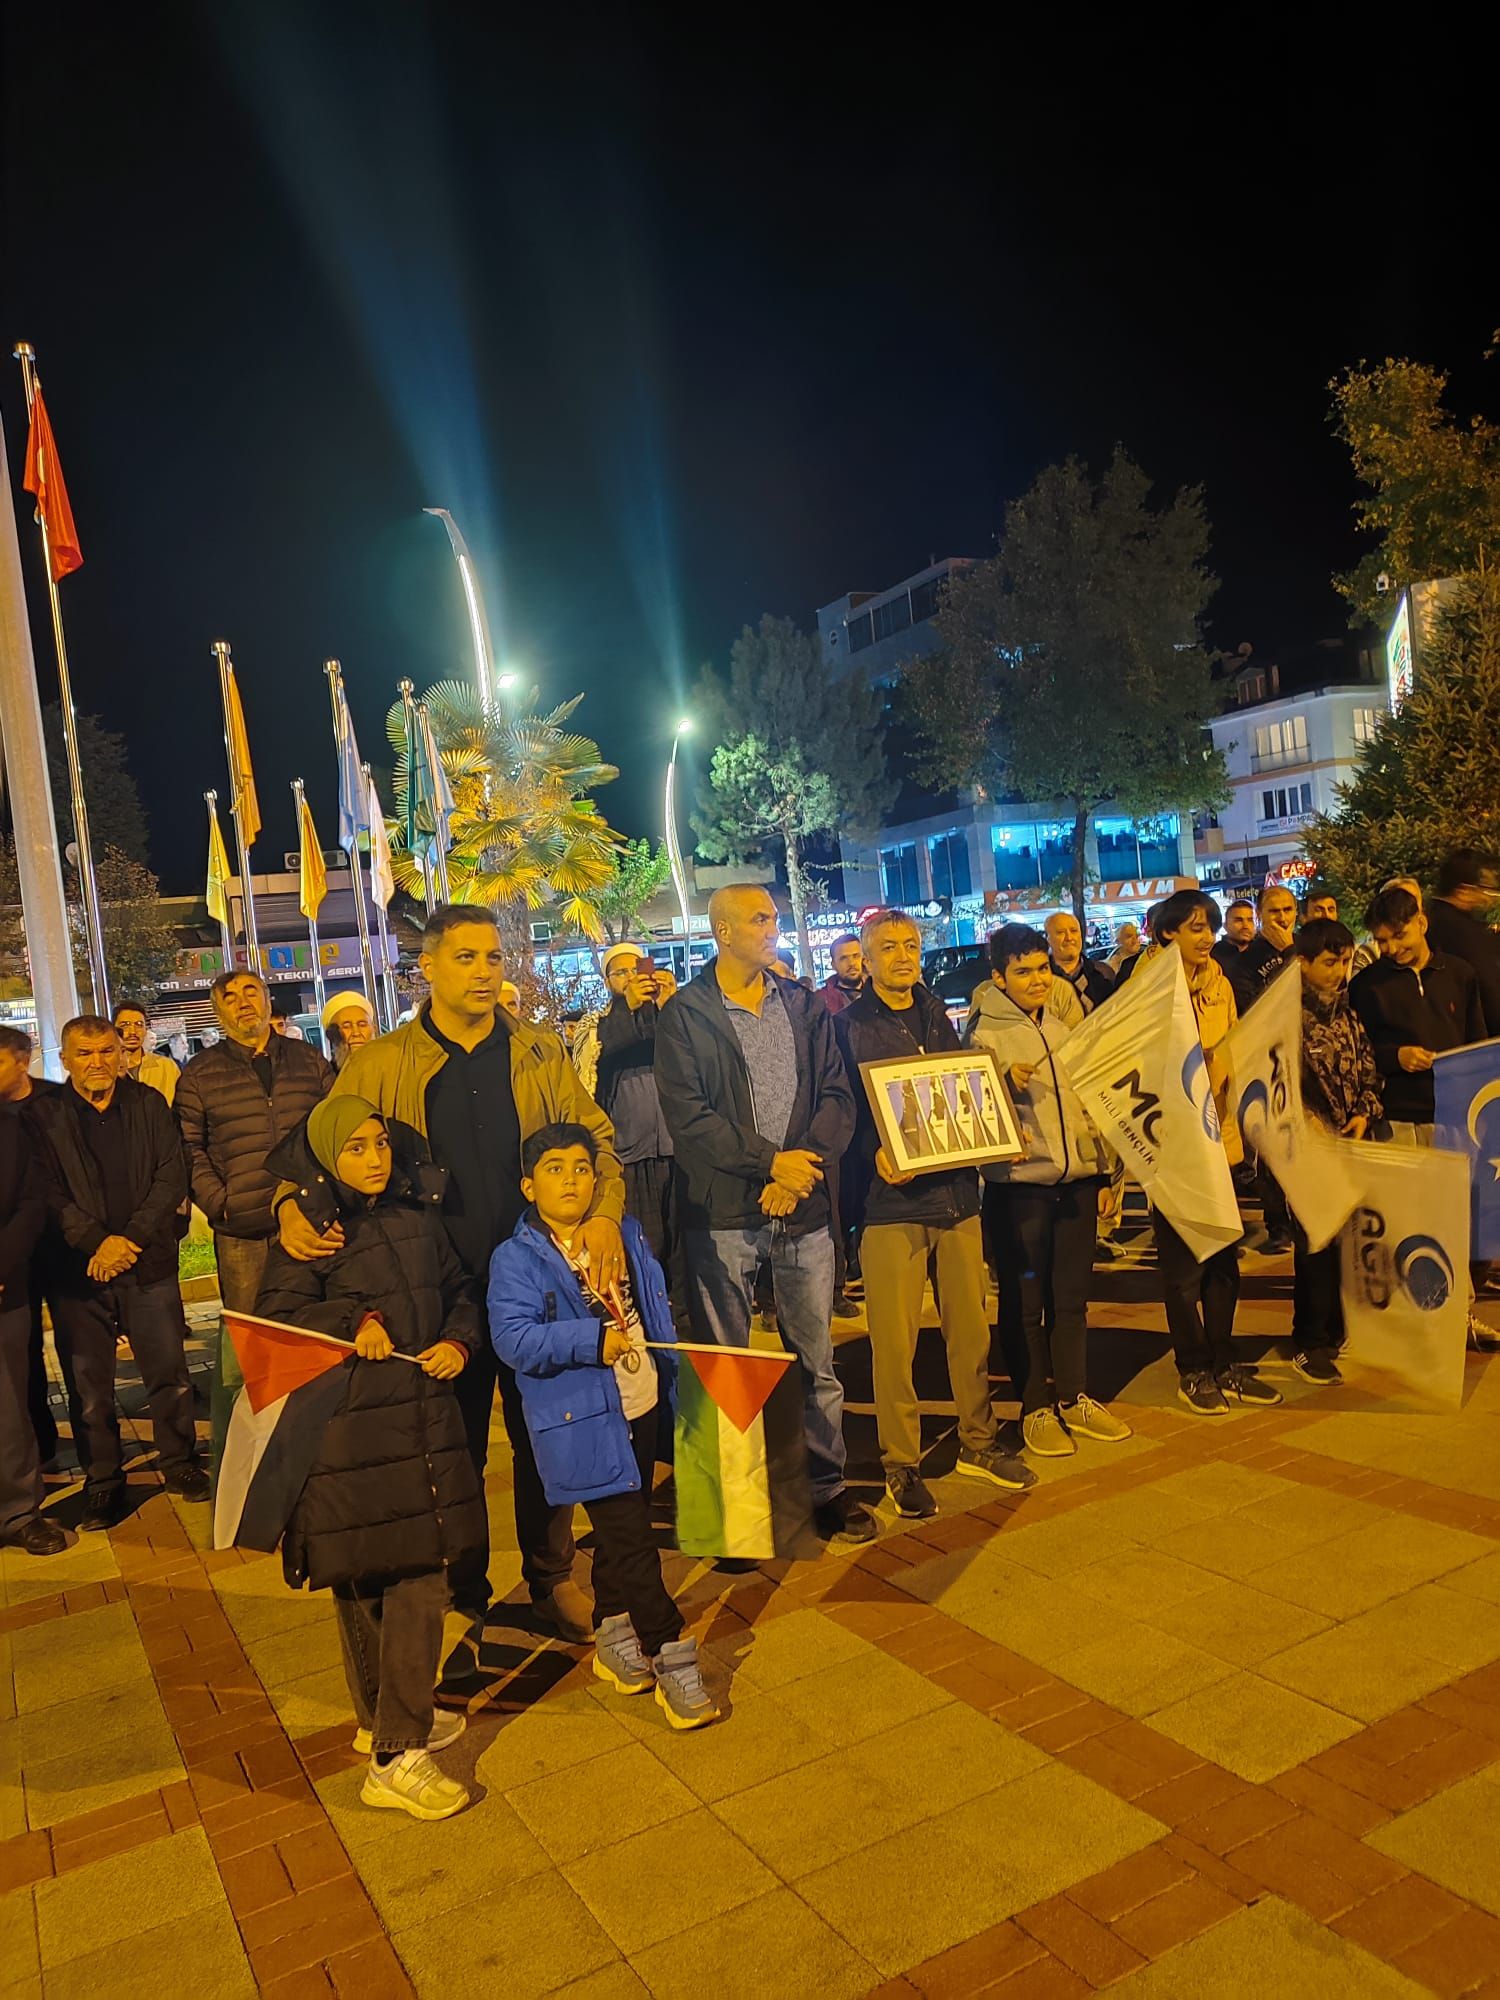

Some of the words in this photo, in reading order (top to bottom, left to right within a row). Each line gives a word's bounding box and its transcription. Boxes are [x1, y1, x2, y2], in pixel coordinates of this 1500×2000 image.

[1118, 879, 1175, 898] AVM
[817, 909, 858, 926] GEDİZ
[276, 967, 315, 981] TEKNİ
[1097, 1090, 1122, 1119] MİLLİ
[1118, 1119, 1156, 1166] GENÇLİK
